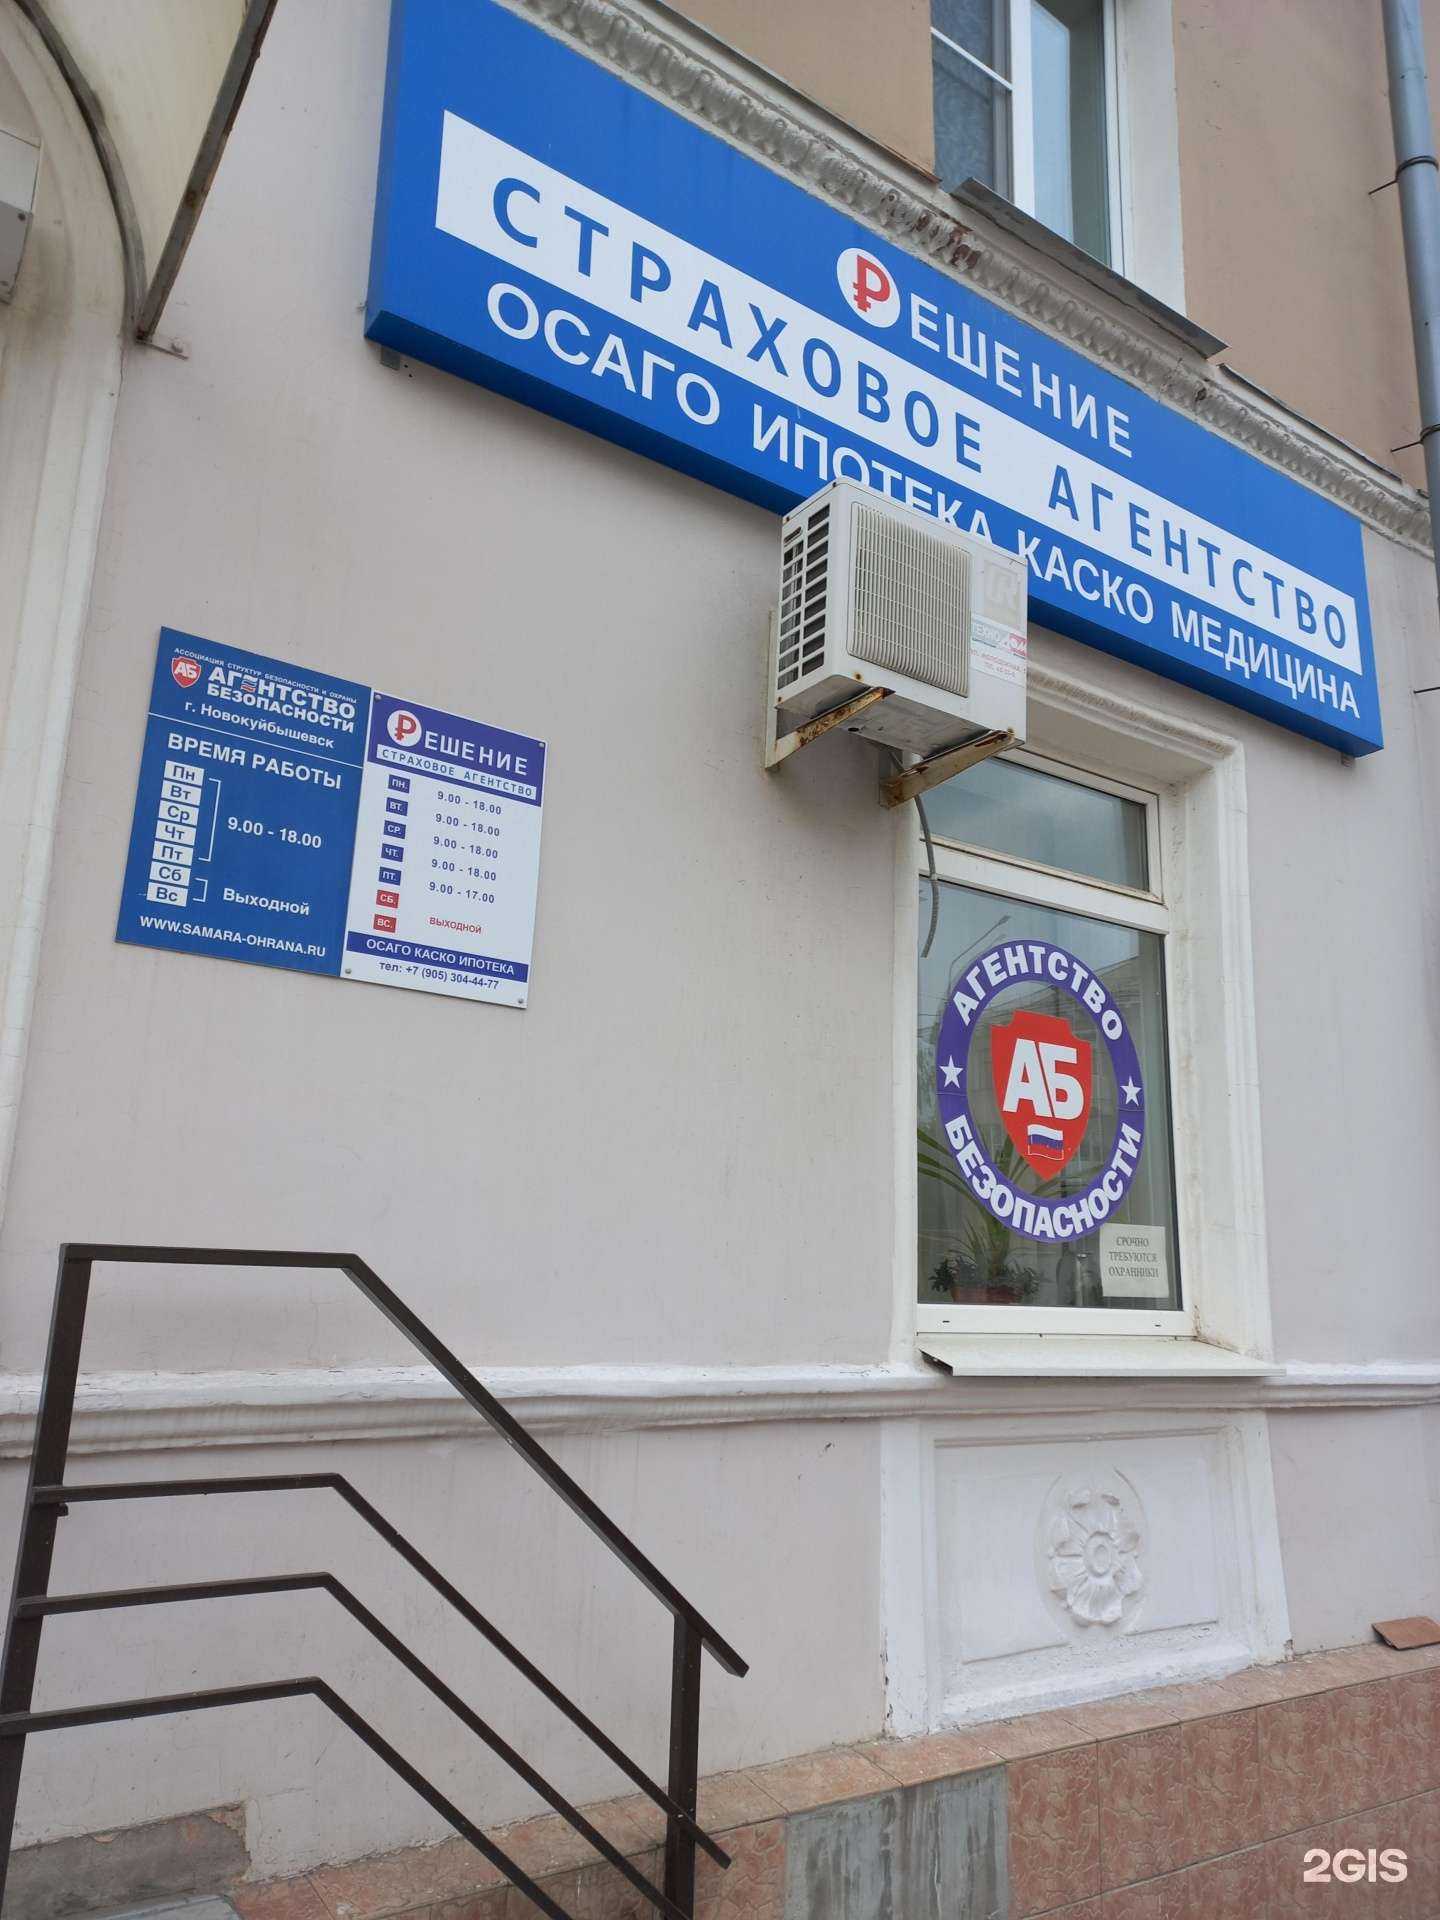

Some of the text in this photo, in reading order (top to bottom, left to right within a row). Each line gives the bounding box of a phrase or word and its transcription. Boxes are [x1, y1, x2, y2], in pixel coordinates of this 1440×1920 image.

[493, 178, 1346, 649] СТРАХОВОЕ АГЕНТСТВО
[487, 283, 720, 425] ОСАГО
[1017, 528, 1154, 624] КАСКО
[1171, 602, 1361, 719] МЕДИЦИНА
[174, 661, 197, 679] АБ
[174, 648, 224, 666] АССОЦИАЦИЯ
[227, 663, 261, 677] СТРУКТУР
[264, 673, 319, 693] БЕЗОПАСНОСТИ
[329, 691, 356, 704] ОХРАНЫ
[208, 666, 356, 719] АГЕНТСТВО
[207, 683, 354, 733] БЕЗОПАСНОСТИ
[201, 703, 334, 749] Новокуйбышевск
[168, 733, 342, 790] ВРЕМЯ РАБОТЫ
[172, 765, 196, 781] Пн
[382, 749, 532, 797] СТРАХОВОЕ АГЕНТСТВО
[170, 785, 192, 800] Вт
[391, 779, 408, 789] ПН.
[167, 805, 190, 823] Ср
[389, 802, 404, 812] ВТ.
[437, 791, 461, 804] 9.00
[473, 800, 502, 815] 18.00
[164, 825, 185, 841] Чт
[227, 816, 263, 836] 9.00
[279, 828, 322, 849] 18.00
[387, 824, 402, 835] СР.
[435, 813, 459, 826] 9.00
[471, 822, 500, 837] 18.00
[161, 846, 183, 861] Пт
[384, 847, 399, 857] ЧТ.
[433, 836, 457, 849] 9.00
[470, 844, 498, 859] 18.00
[159, 866, 182, 882] Сб
[381, 871, 397, 881] ПТ.
[431, 859, 454, 872] 9.00
[468, 867, 496, 881] 18.00
[156, 887, 178, 902] Вс
[223, 887, 310, 916] Выходной
[379, 894, 396, 904] СБ.
[429, 881, 453, 894] 9.00
[466, 889, 495, 904] 17.00
[376, 918, 393, 928] ВС.
[429, 917, 482, 934] ВЫХОДНОЙ
[139, 915, 326, 957] WWW.SAMARA-OHRANA.RU
[366, 938, 515, 975] ОСАГО КАСКО ИПОТЕКА
[379, 962, 500, 990] тел: +7 (905) 304-44-77
[952, 944, 1123, 1040] АГЕНТСТВО
[1003, 1038, 1084, 1120] АБ
[945, 1114, 1142, 1238] БЕЗОПАСНОСТИ
[1116, 1236, 1149, 1247] СРОЧНО
